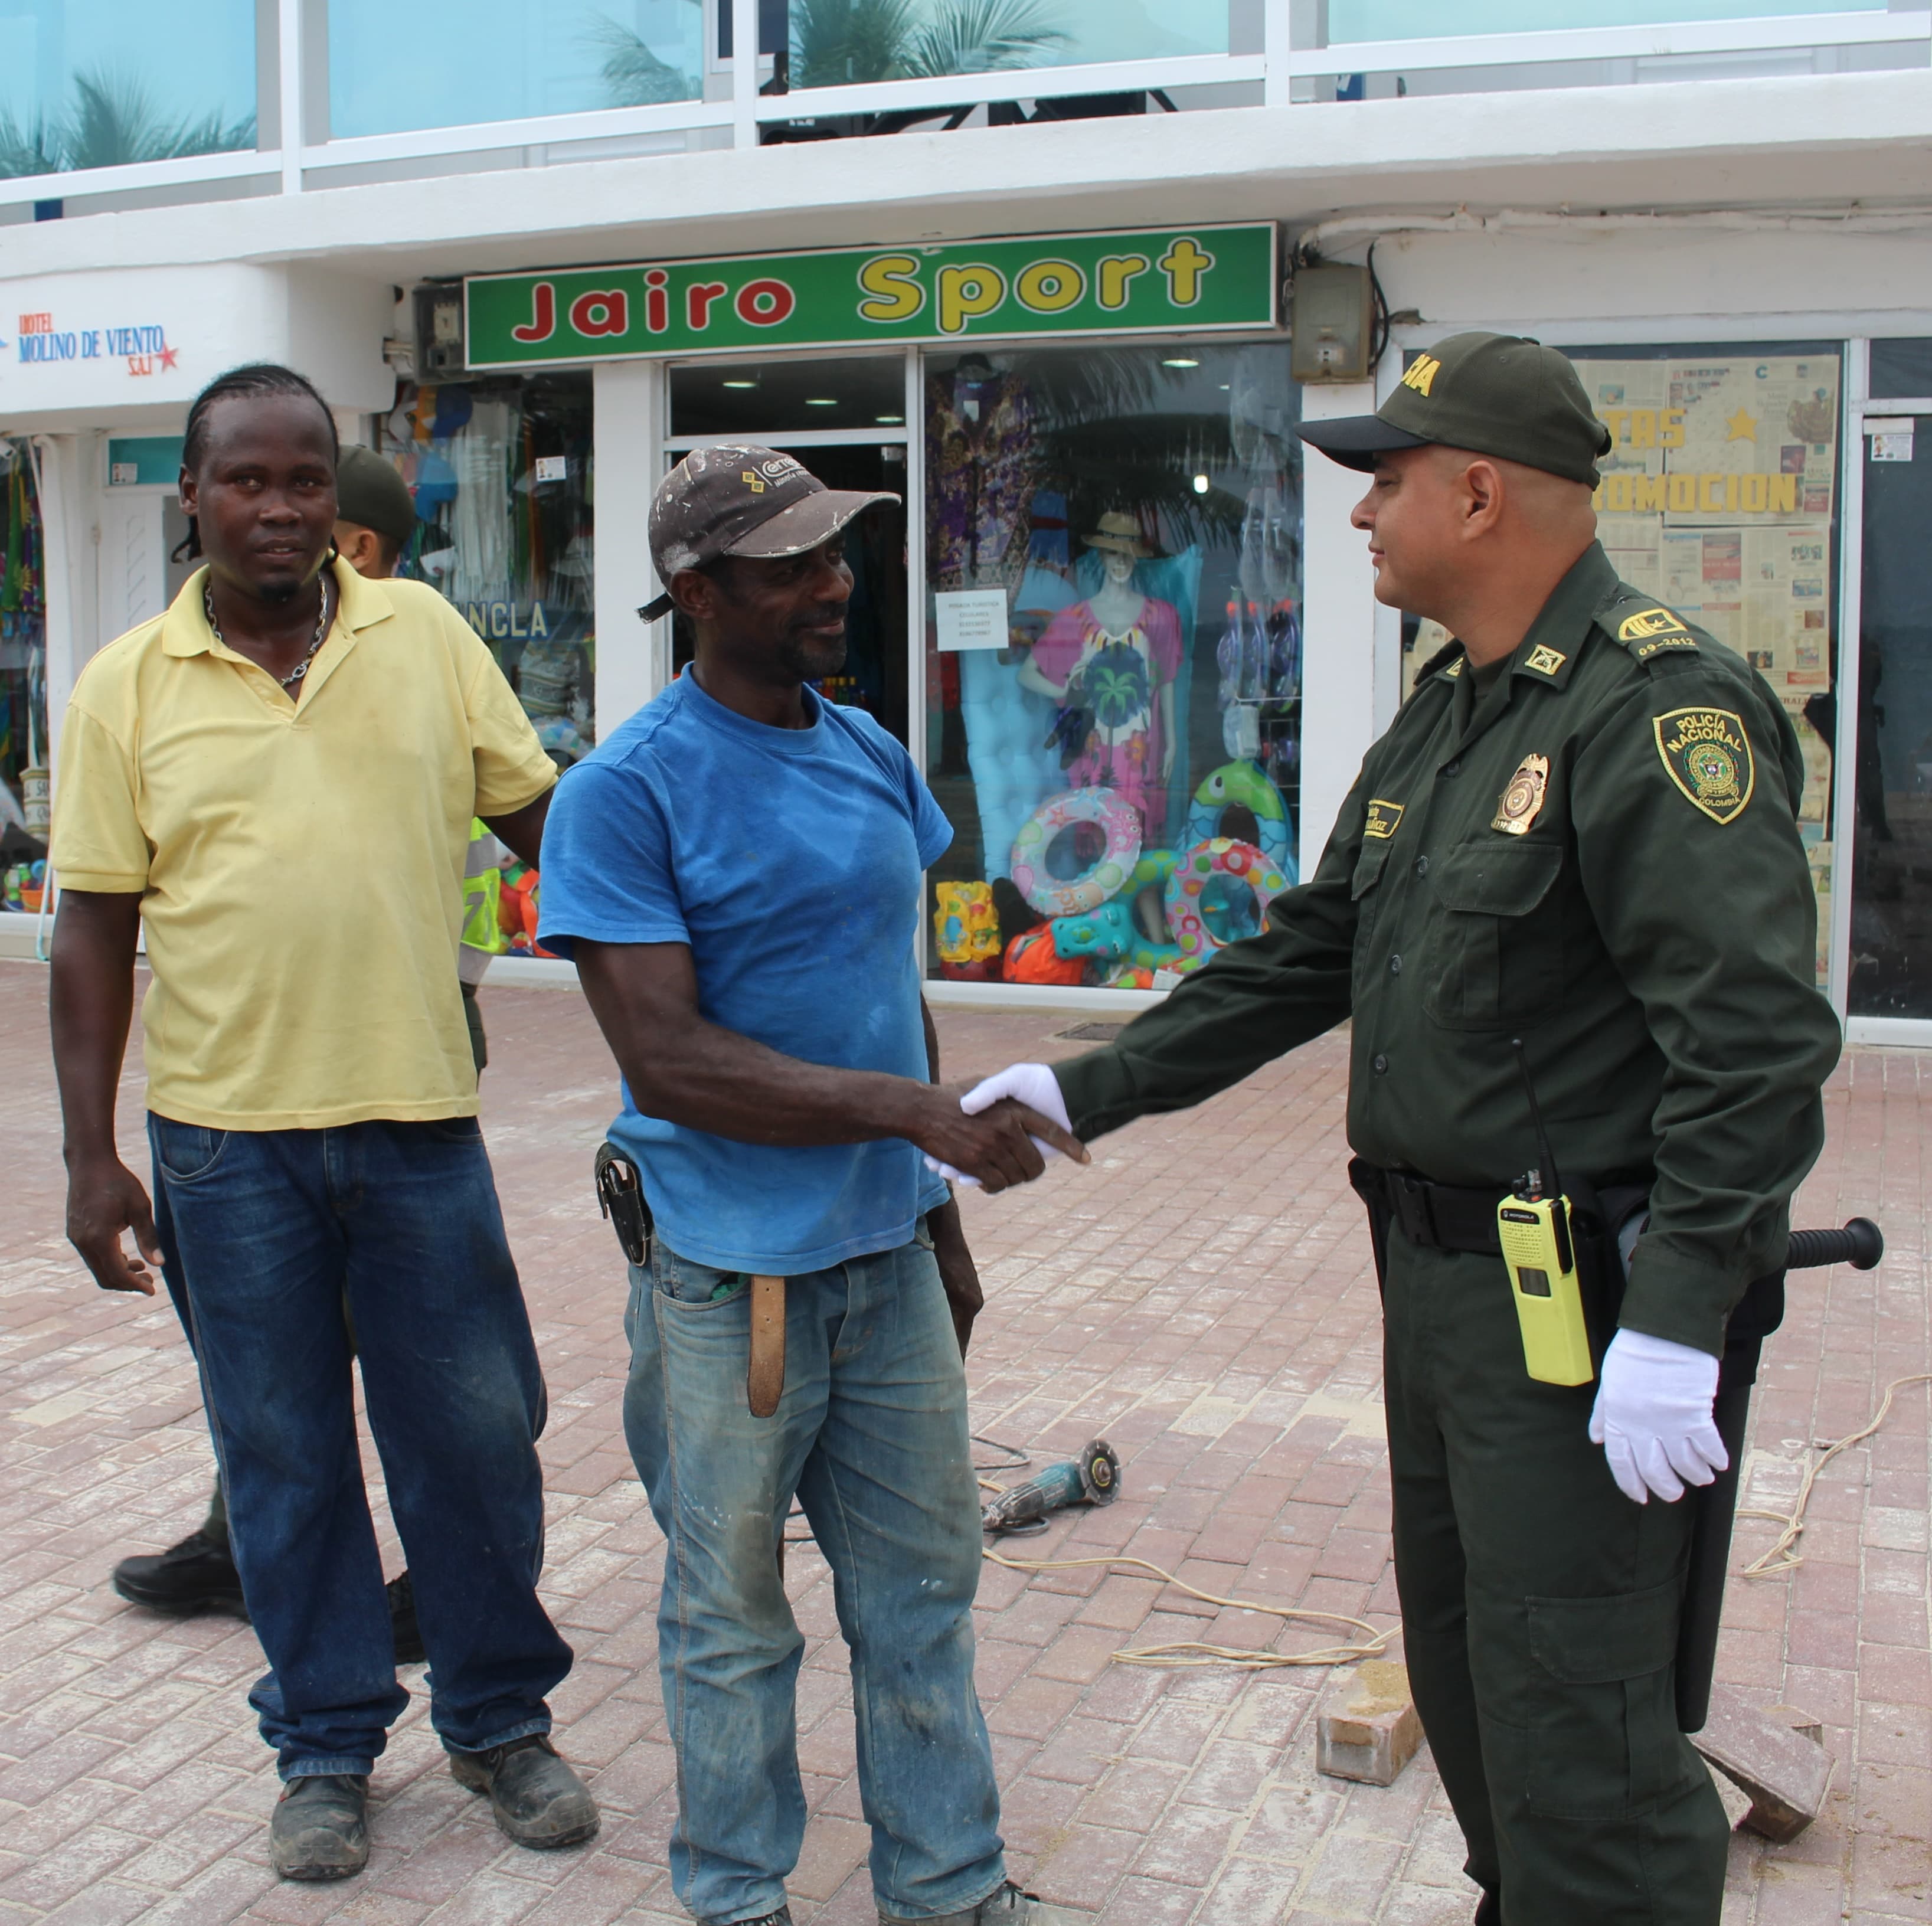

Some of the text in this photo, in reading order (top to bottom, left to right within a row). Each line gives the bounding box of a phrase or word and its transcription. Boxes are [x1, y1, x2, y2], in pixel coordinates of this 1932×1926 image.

[511, 236, 1217, 344] Jairo Sport
[19, 312, 54, 335] HOTEL
[19, 325, 164, 363] MOLINO DE VIENTO
[1594, 408, 1685, 449] TAS
[453, 601, 548, 637] NCLA
[1638, 637, 1696, 656] 09-2012
[1666, 728, 1743, 754] NACIONAL
[1699, 796, 1741, 807] COLOMBIA
